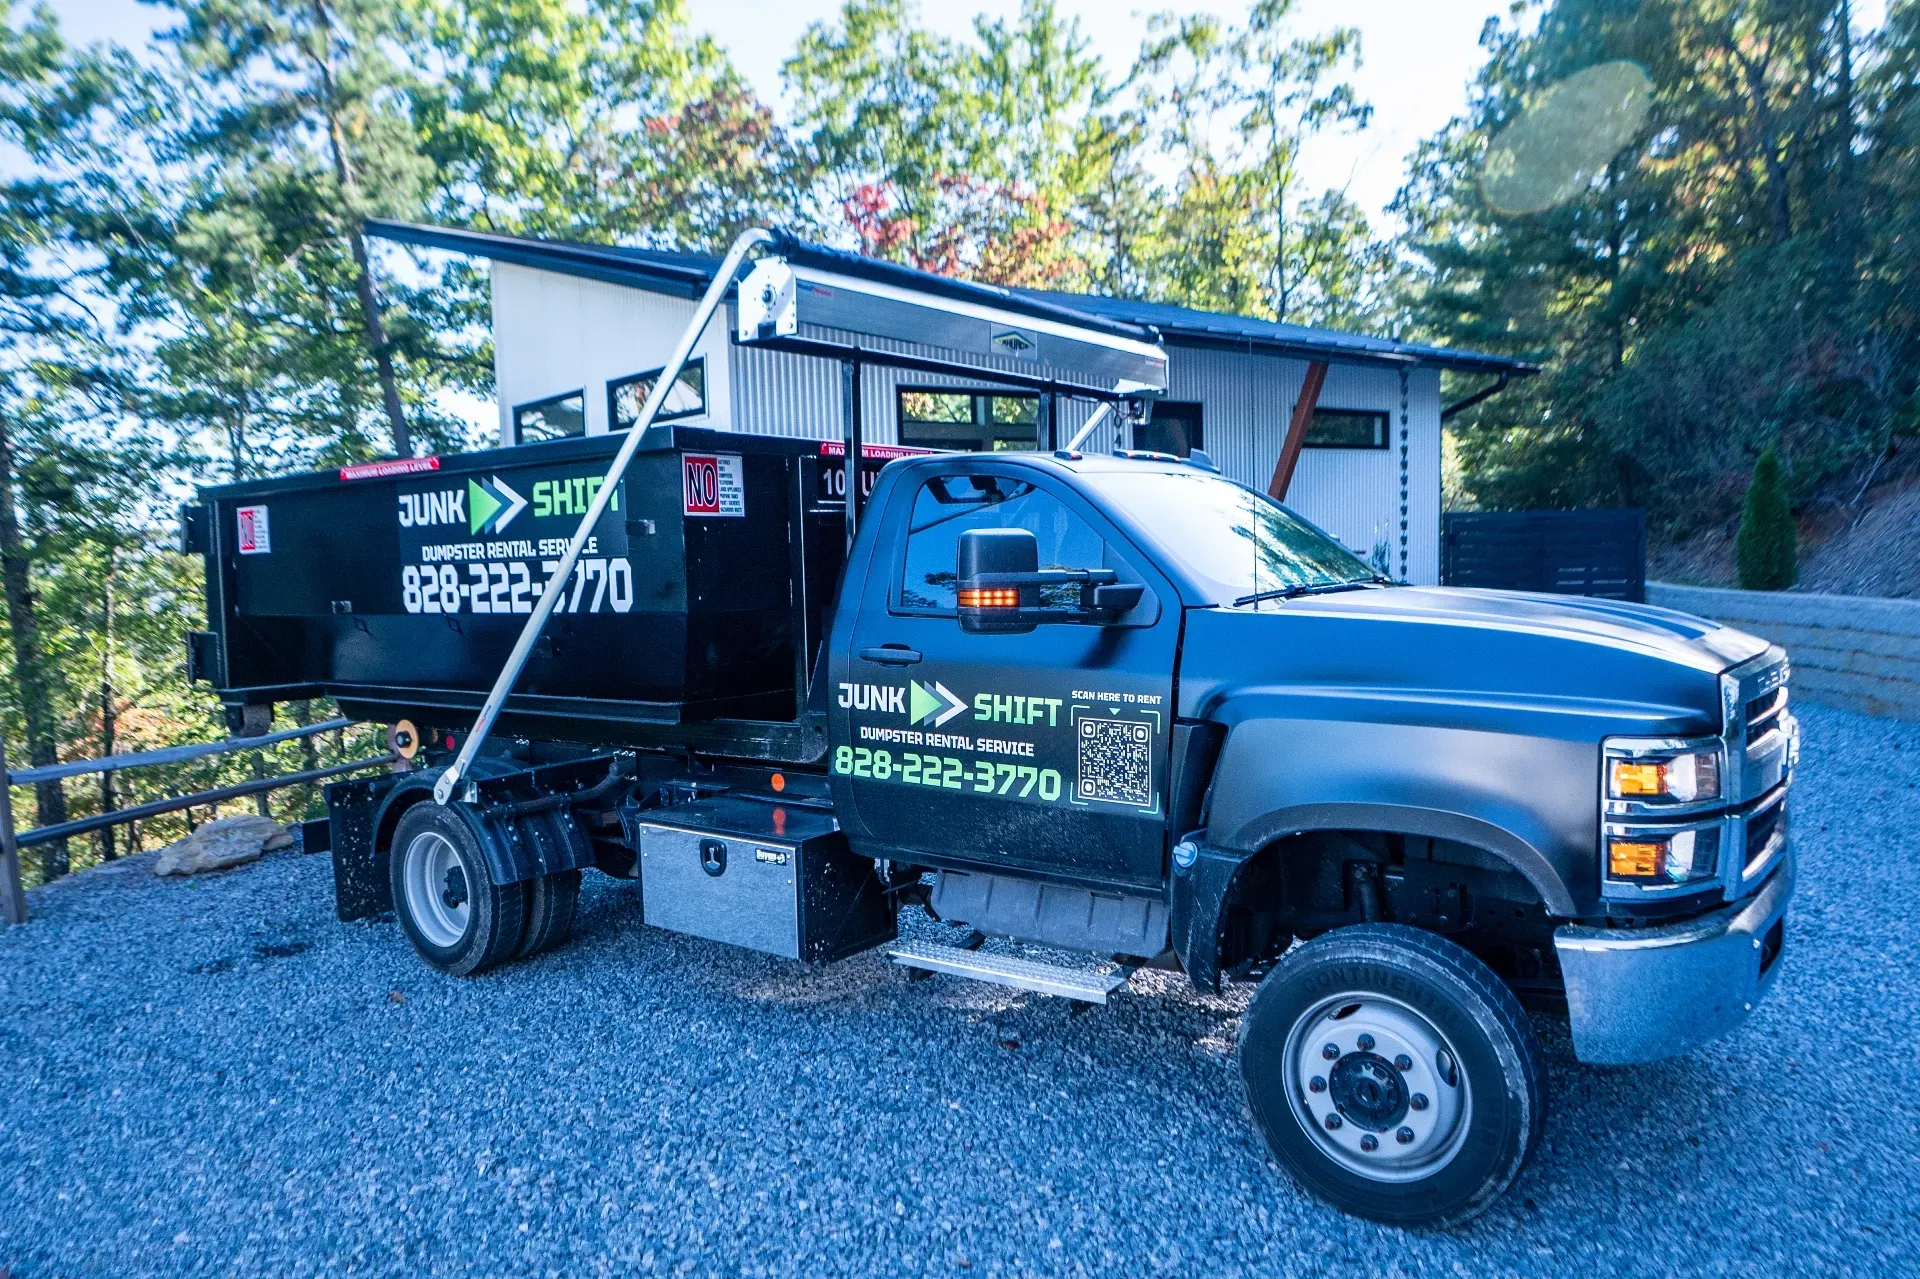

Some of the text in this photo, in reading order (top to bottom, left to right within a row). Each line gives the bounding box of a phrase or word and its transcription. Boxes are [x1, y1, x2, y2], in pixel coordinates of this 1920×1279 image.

[828, 446, 868, 458] MAXM
[870, 449, 904, 459] LOADING
[687, 463, 717, 507] NO
[398, 489, 467, 528] JUNK
[422, 536, 598, 562] DUMPSTER RENTAL SERVE
[837, 683, 1063, 727] JUNK SHIFT
[1071, 690, 1162, 706] SCAN HERE TO RENT
[860, 726, 1035, 757] DUMPSTER RENTAL SERVICE
[834, 745, 1062, 802] 828-222-3770
